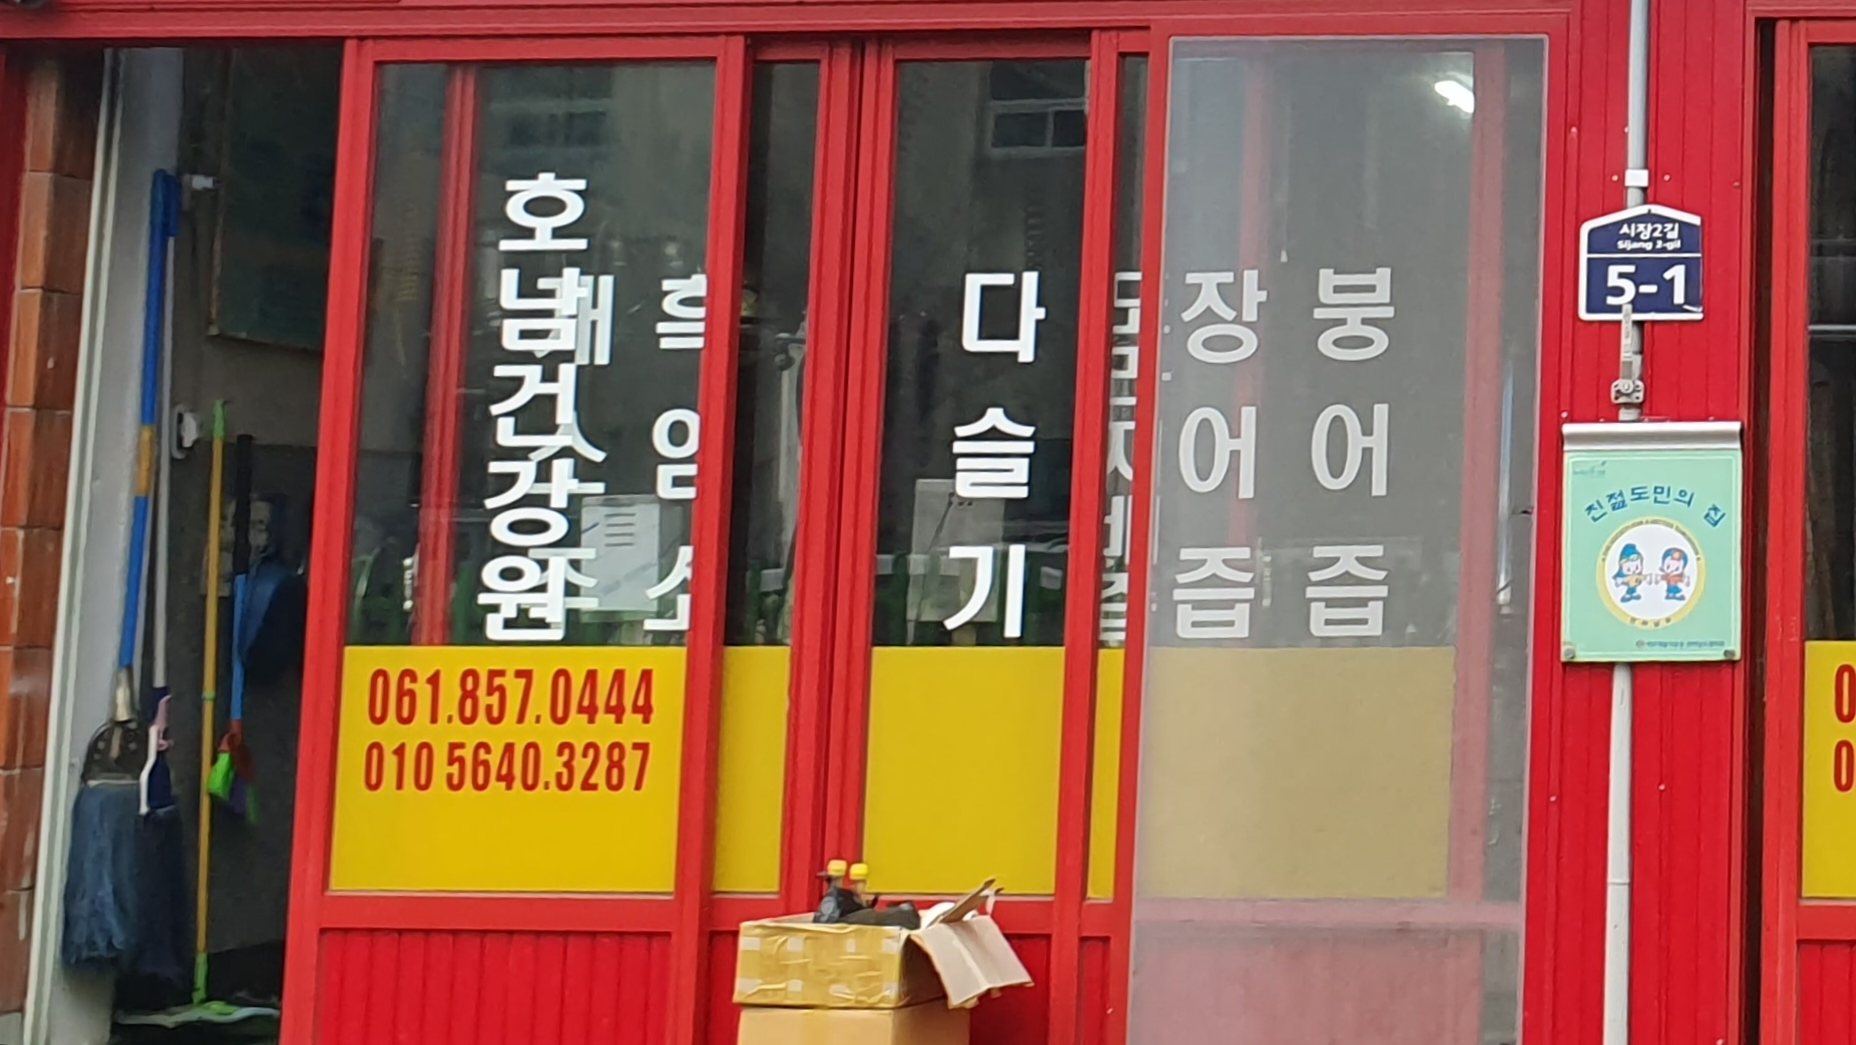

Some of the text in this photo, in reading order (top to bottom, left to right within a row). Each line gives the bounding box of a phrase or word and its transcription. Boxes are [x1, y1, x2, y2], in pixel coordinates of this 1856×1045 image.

[1606, 264, 1686, 306] 5-1
[1617, 239, 1653, 251] Sijang
[1618, 222, 1679, 240] 시장2길
[477, 172, 592, 641] 호남건강원
[942, 270, 1046, 639] 다슬기
[1171, 268, 1268, 639] 장어즙
[1305, 266, 1396, 638] 붕어즙
[367, 668, 655, 726] 061.857.0444
